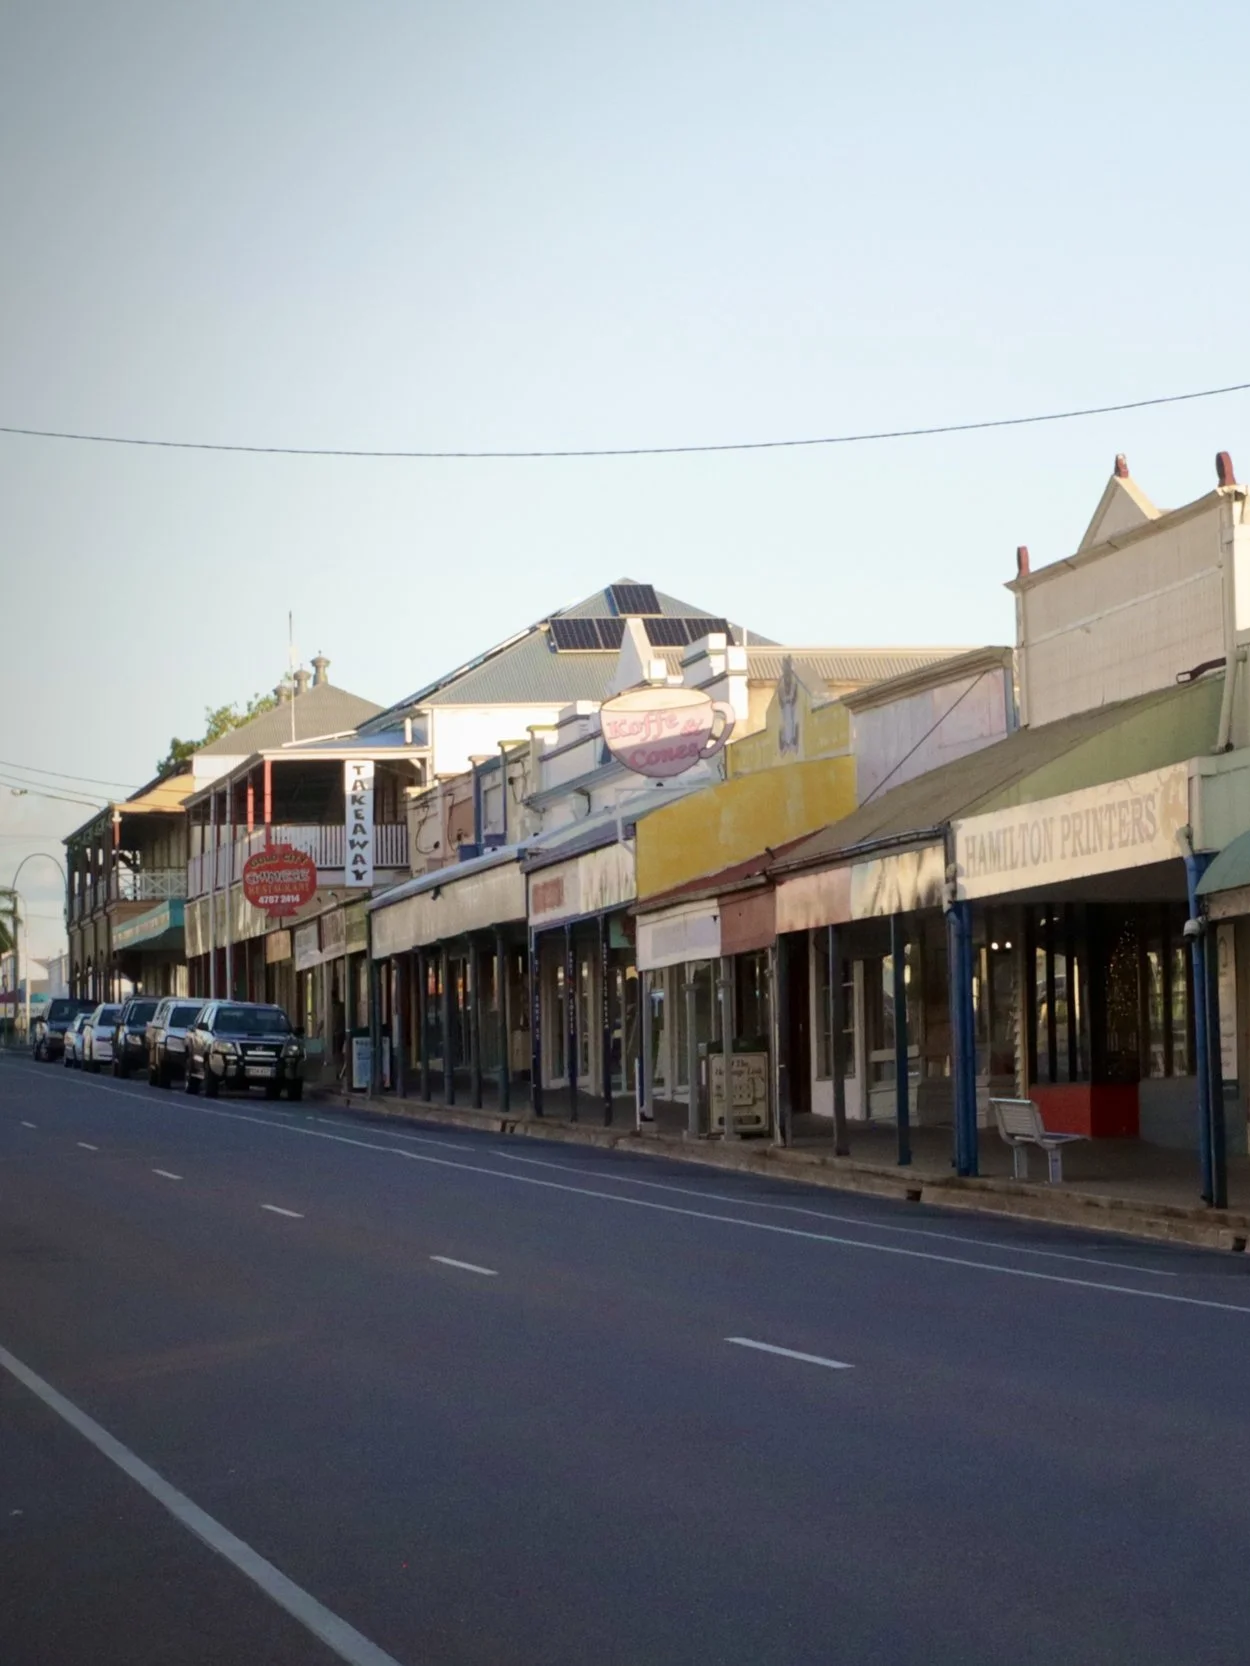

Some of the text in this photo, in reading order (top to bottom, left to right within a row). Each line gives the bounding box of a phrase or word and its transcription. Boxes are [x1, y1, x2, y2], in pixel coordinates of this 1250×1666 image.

[606, 711, 680, 742] Koffe
[628, 743, 699, 770] Cones
[349, 765, 370, 881] TAKEAWAY
[964, 793, 1158, 878] HAMILTON PRINTERS
